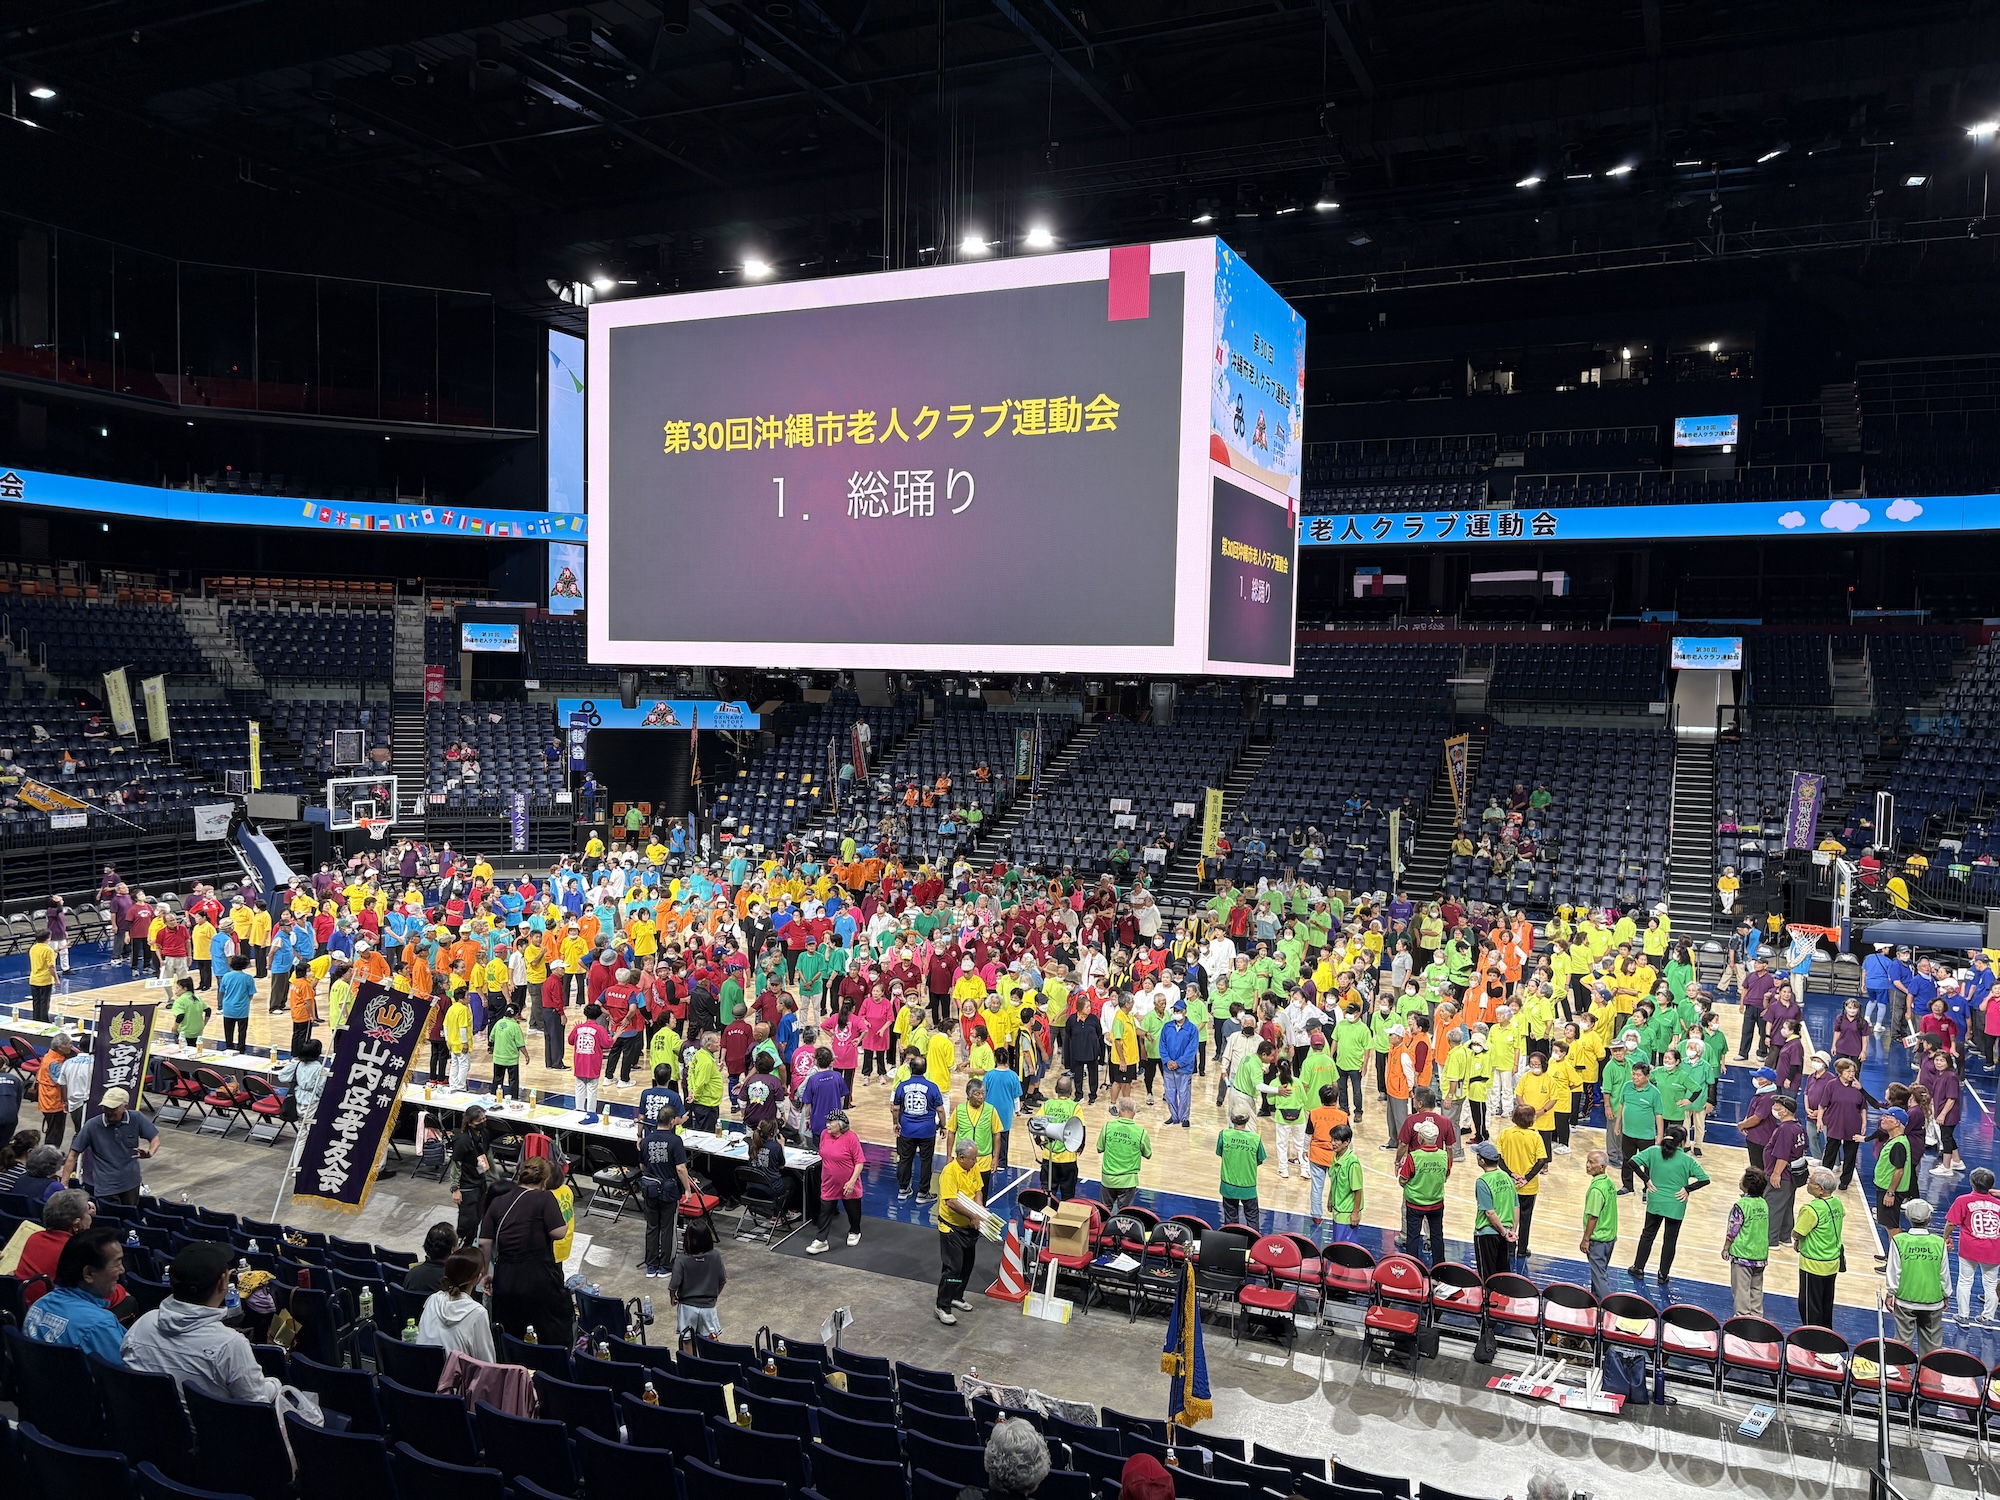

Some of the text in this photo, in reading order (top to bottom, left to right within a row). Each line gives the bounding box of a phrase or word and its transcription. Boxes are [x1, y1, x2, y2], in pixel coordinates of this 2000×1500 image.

[663, 393, 1120, 454] 第30回沖縄市老人クラブ運動会
[0, 471, 25, 499] 会
[846, 467, 976, 520] 総踊り
[377, 1003, 403, 1028] 山
[103, 1044, 137, 1088] 宮里
[375, 1054, 406, 1109] 沖縄市
[317, 1039, 391, 1194] 山内区老友会
[905, 1091, 927, 1114] 睦
[1972, 1211, 1999, 1237] 睦
[1908, 1246, 1934, 1254] かりゆし
